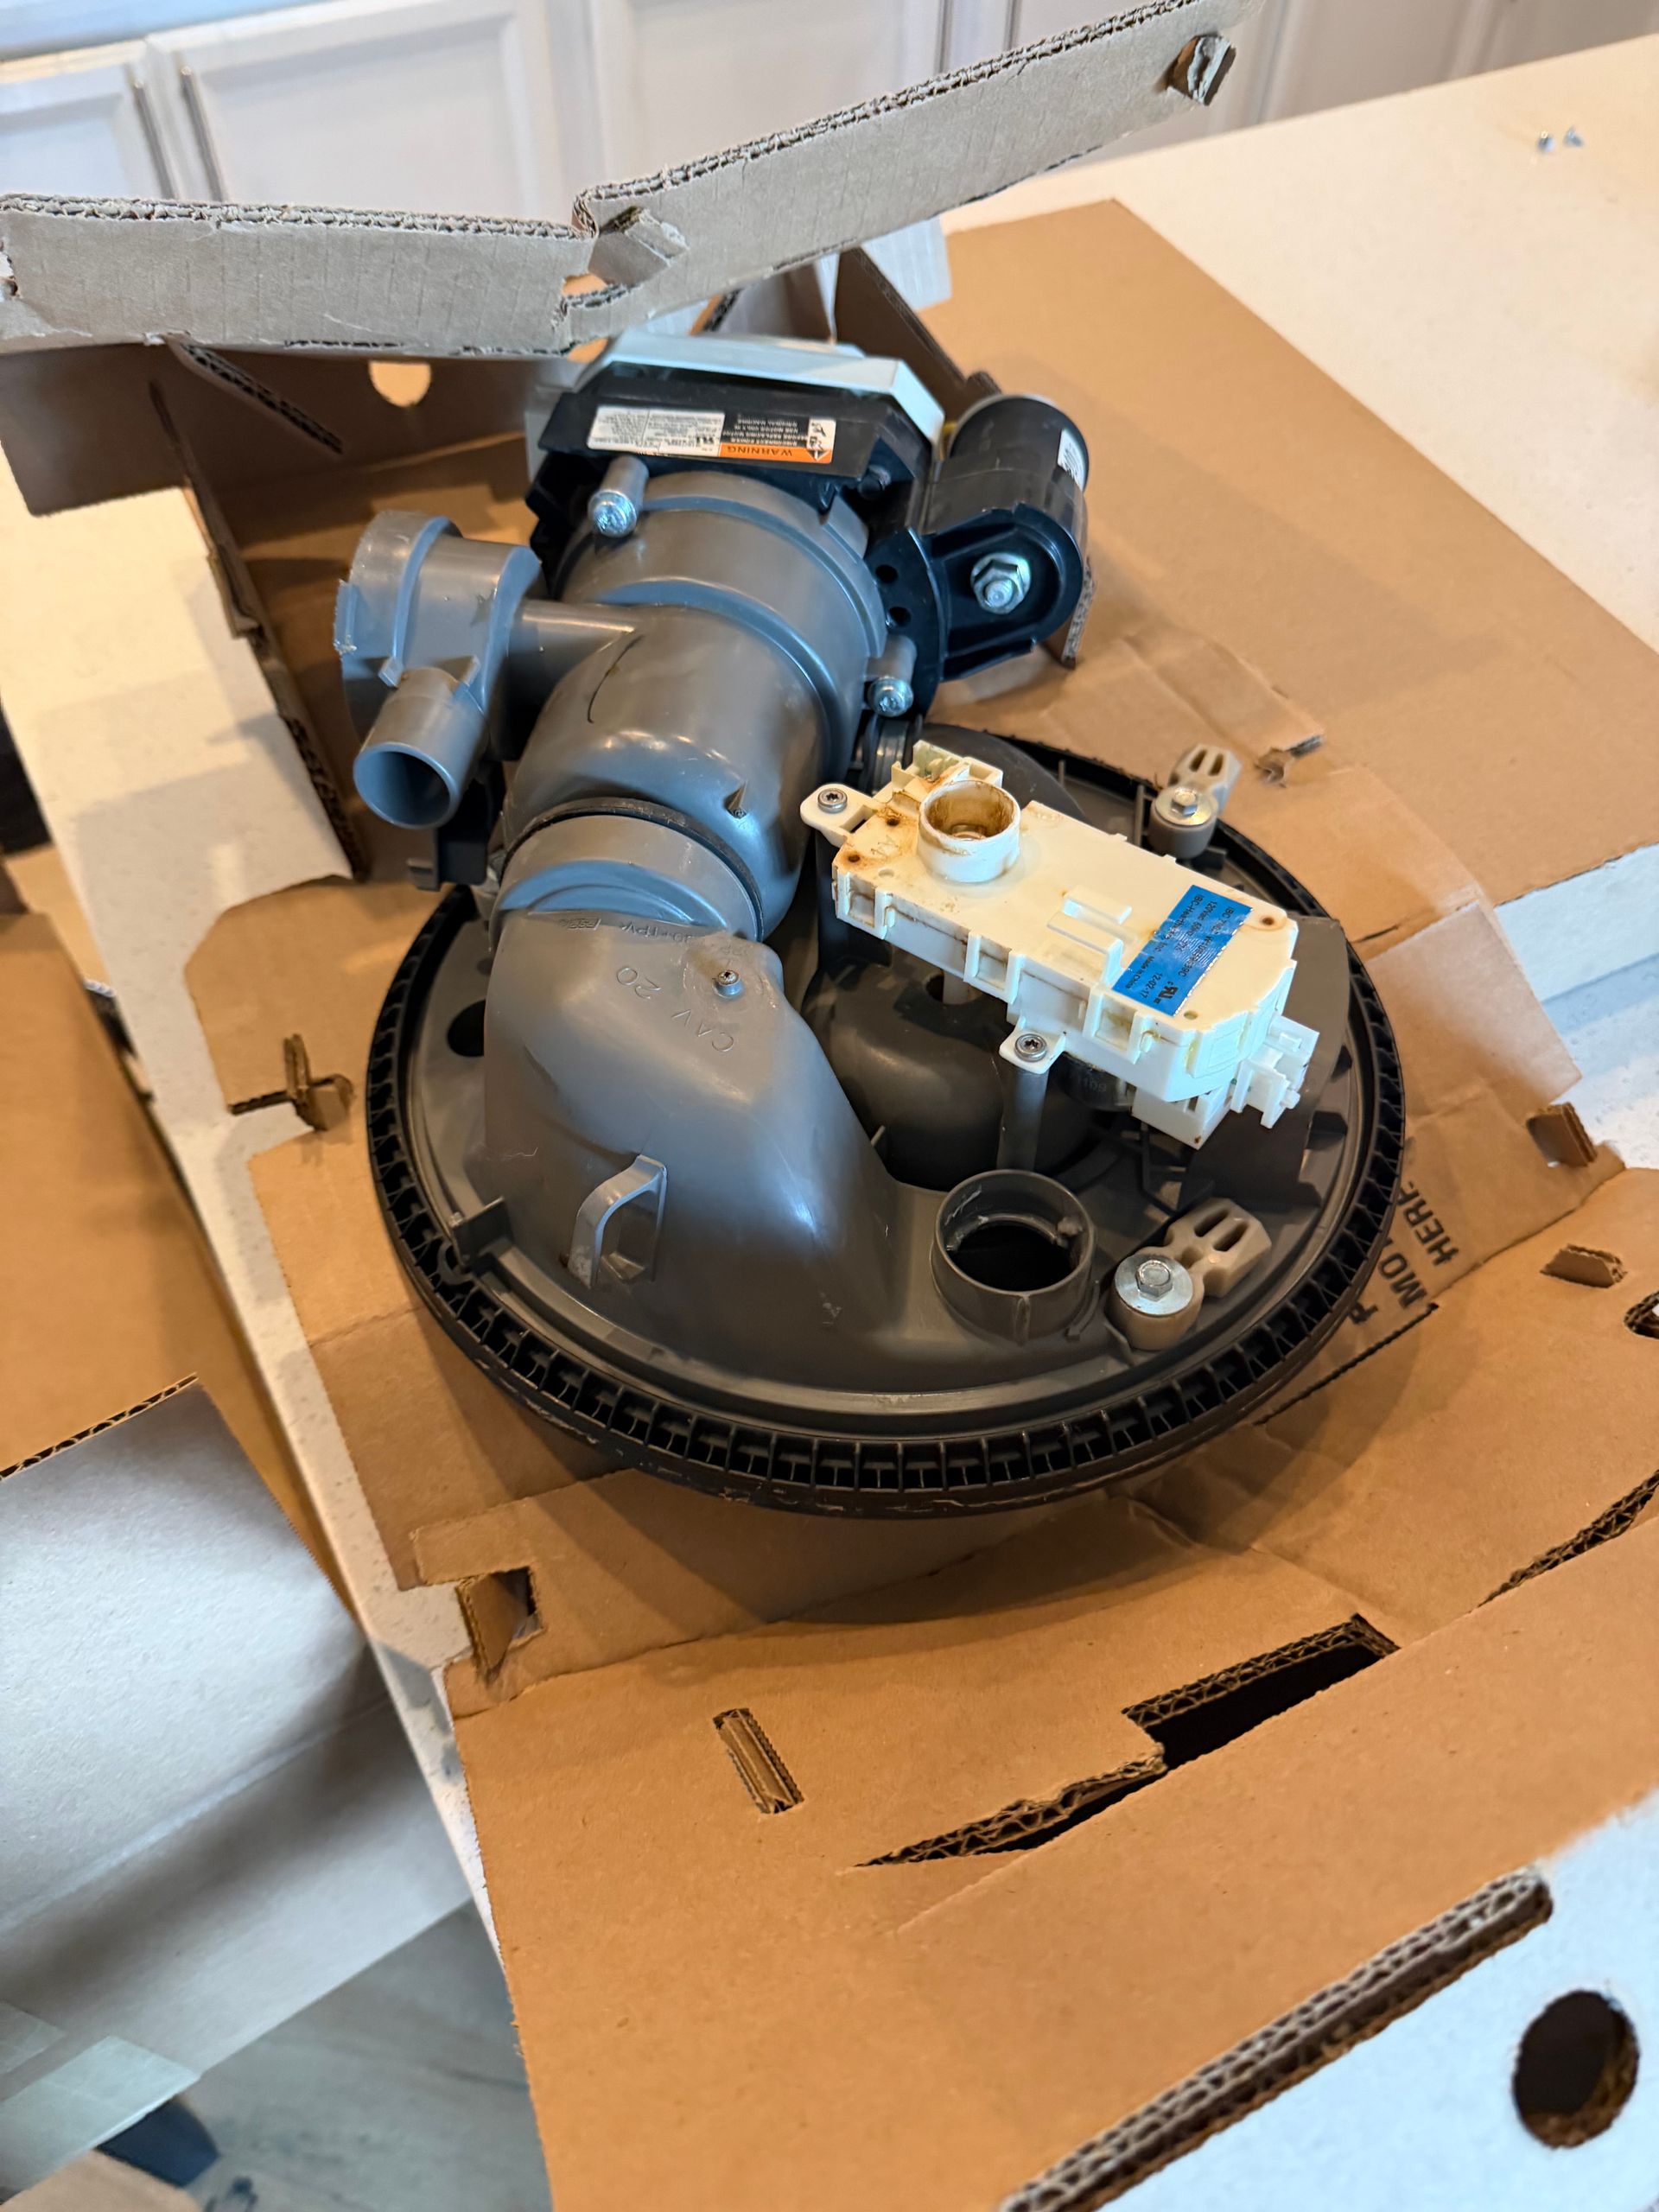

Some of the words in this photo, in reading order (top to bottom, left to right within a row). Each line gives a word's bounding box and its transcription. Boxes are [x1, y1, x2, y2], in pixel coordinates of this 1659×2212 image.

[728, 446, 792, 456] WARNING
[617, 967, 662, 1000] 20
[1140, 973, 1162, 998] 12-02-17
[671, 1009, 734, 1052] CAV
